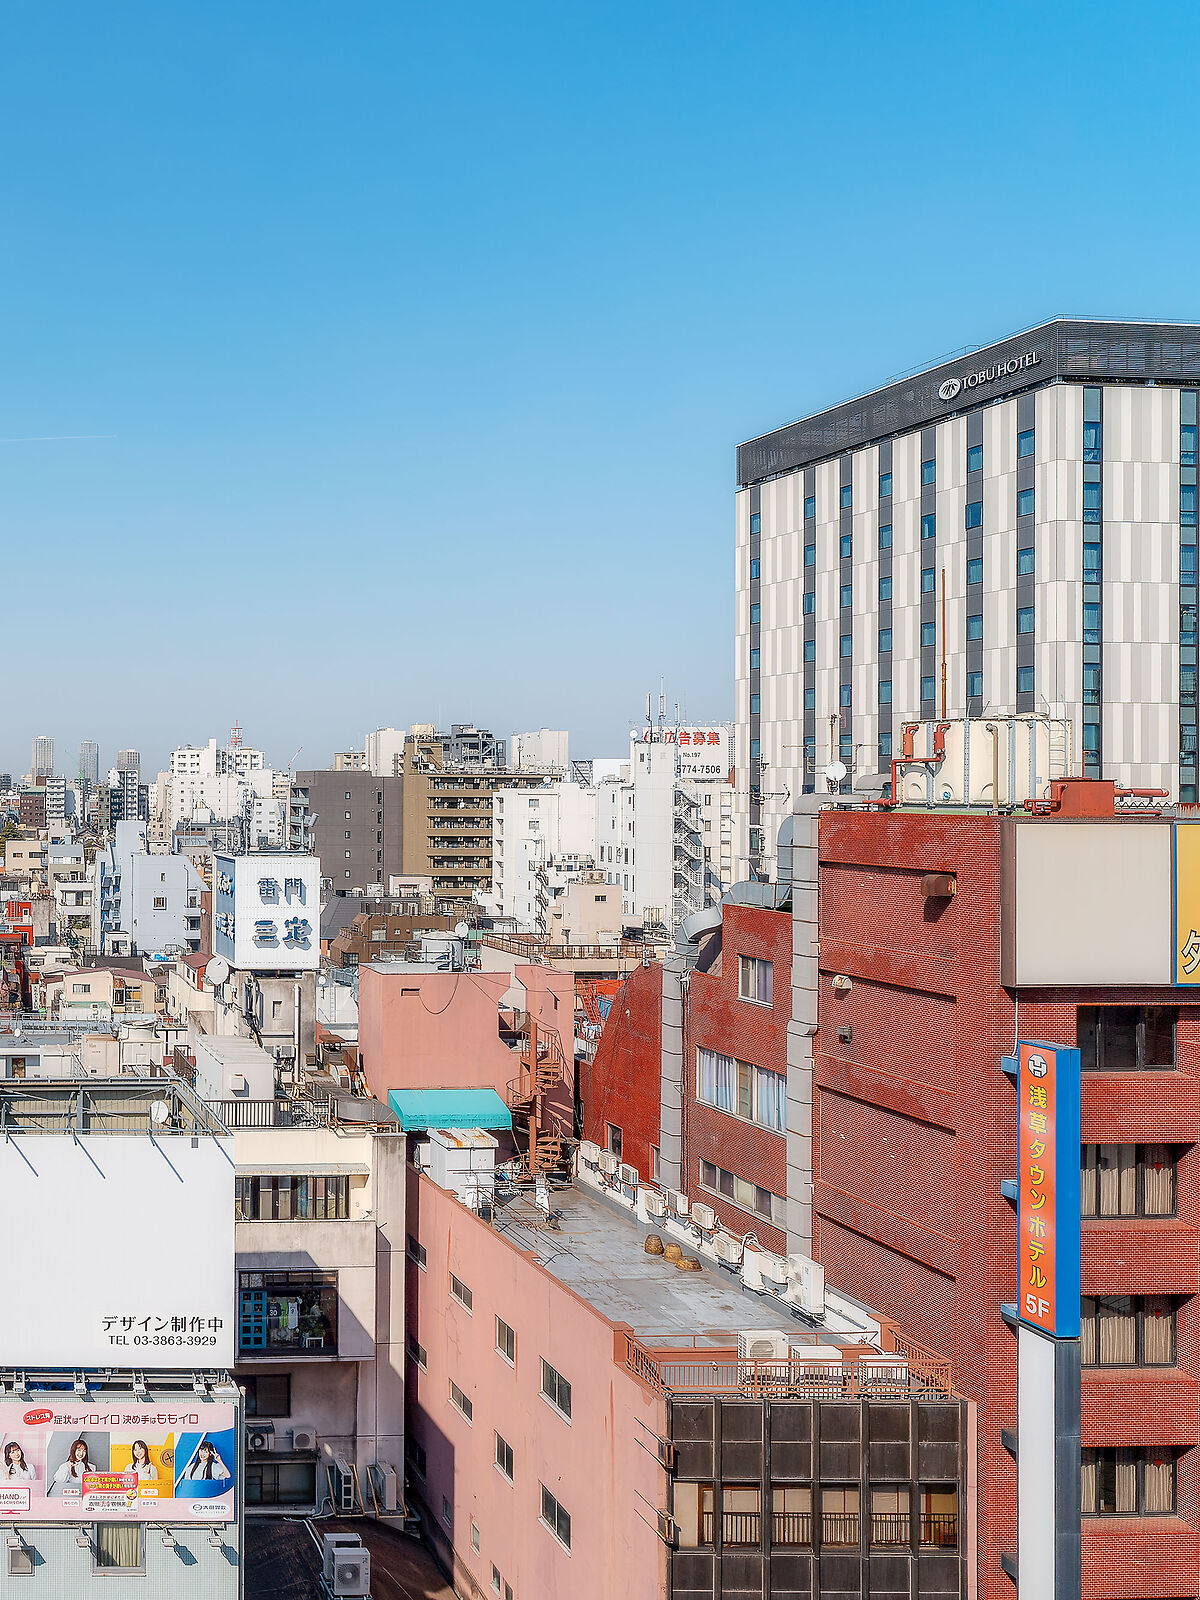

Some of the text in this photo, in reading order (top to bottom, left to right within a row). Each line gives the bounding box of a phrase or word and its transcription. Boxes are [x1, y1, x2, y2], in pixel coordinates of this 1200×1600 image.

[961, 351, 1040, 389] TOBU HOTEL
[257, 877, 304, 898] 雷門
[253, 917, 309, 942] 三定
[1028, 1085, 1048, 1289] 浅草タウンホテル
[1025, 1292, 1050, 1319] 5F
[102, 1315, 224, 1333] デザイン制作中
[108, 1335, 217, 1346] TEL 03-3863-3929
[53, 1414, 120, 1425] 症状はイロイロ
[122, 1413, 199, 1425] 決め手はももイロ
